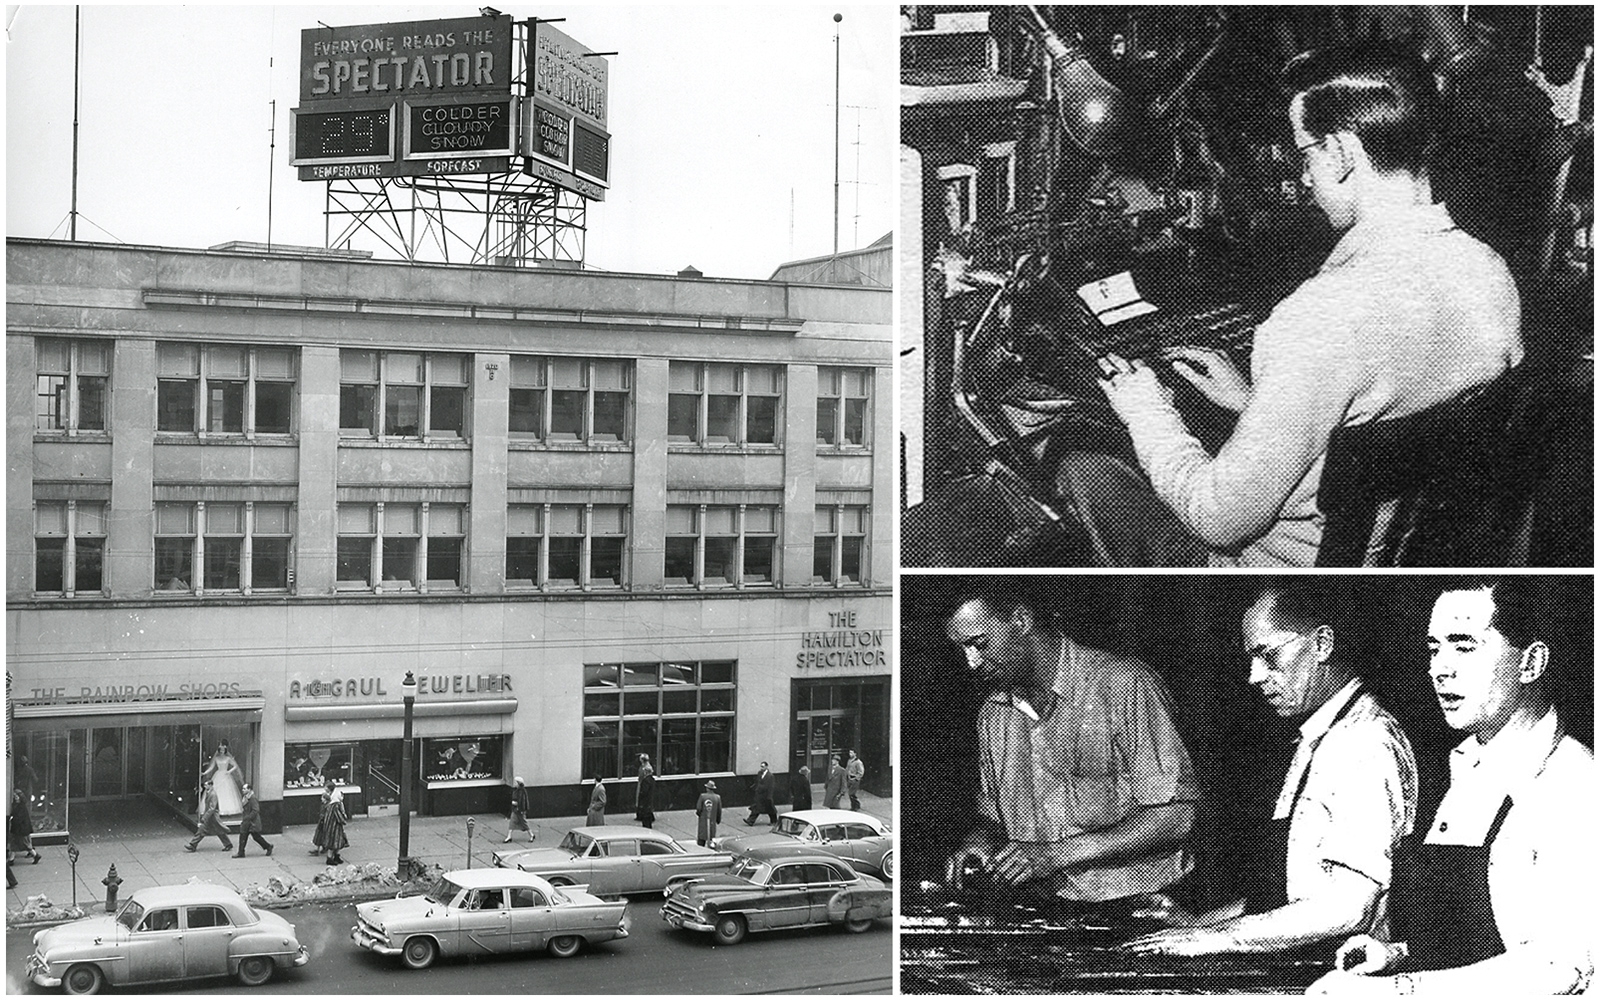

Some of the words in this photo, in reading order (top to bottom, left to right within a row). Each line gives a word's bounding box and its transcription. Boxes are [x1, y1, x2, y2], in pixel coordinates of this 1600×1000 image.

[313, 36, 395, 56] EVERYONE
[402, 32, 457, 50] READS
[463, 30, 493, 46] THE
[311, 51, 495, 96] SPECTATOR
[422, 105, 501, 122] COLDER
[421, 120, 495, 136] CLOUDY
[430, 134, 486, 150] SNOW
[312, 164, 382, 178] TEMPERATURE
[827, 610, 857, 628] THE
[801, 630, 882, 649] HAMILTON
[796, 650, 886, 669] SPECTATOR
[31, 687, 66, 706] THE
[80, 684, 169, 704] RAINBOW
[179, 682, 241, 700] SHOPS
